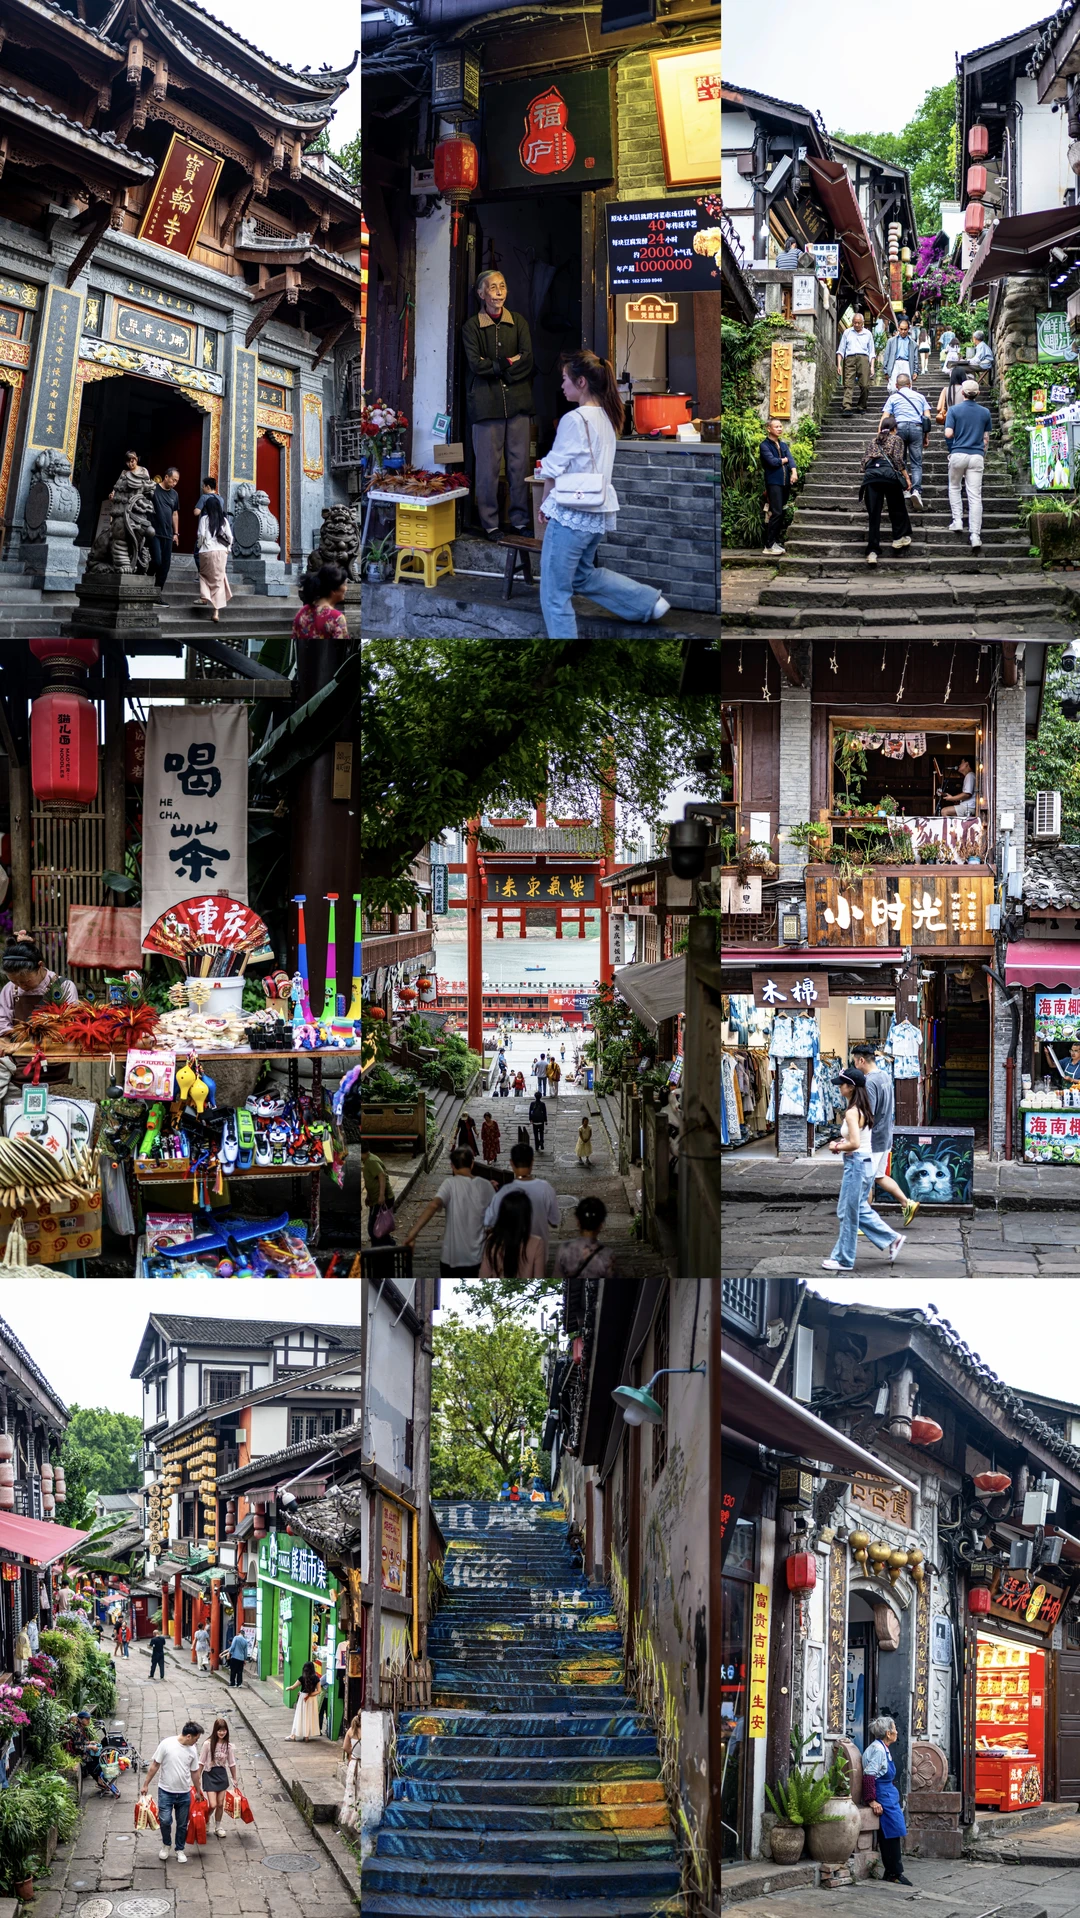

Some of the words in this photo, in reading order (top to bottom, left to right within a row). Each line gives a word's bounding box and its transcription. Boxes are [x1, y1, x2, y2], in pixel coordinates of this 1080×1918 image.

[163, 153, 205, 246] 寶輪寺
[159, 798, 173, 807] HE
[159, 811, 181, 820] CHA
[164, 742, 231, 884] 喝茶
[187, 898, 247, 942] 重庆
[823, 891, 947, 932] 小时光
[762, 977, 819, 1006] 木棉
[279, 1554, 291, 1569] PANDA
[291, 1546, 327, 1589] 熊猫市集
[751, 1593, 768, 1731] 富贵吉祥一生安
